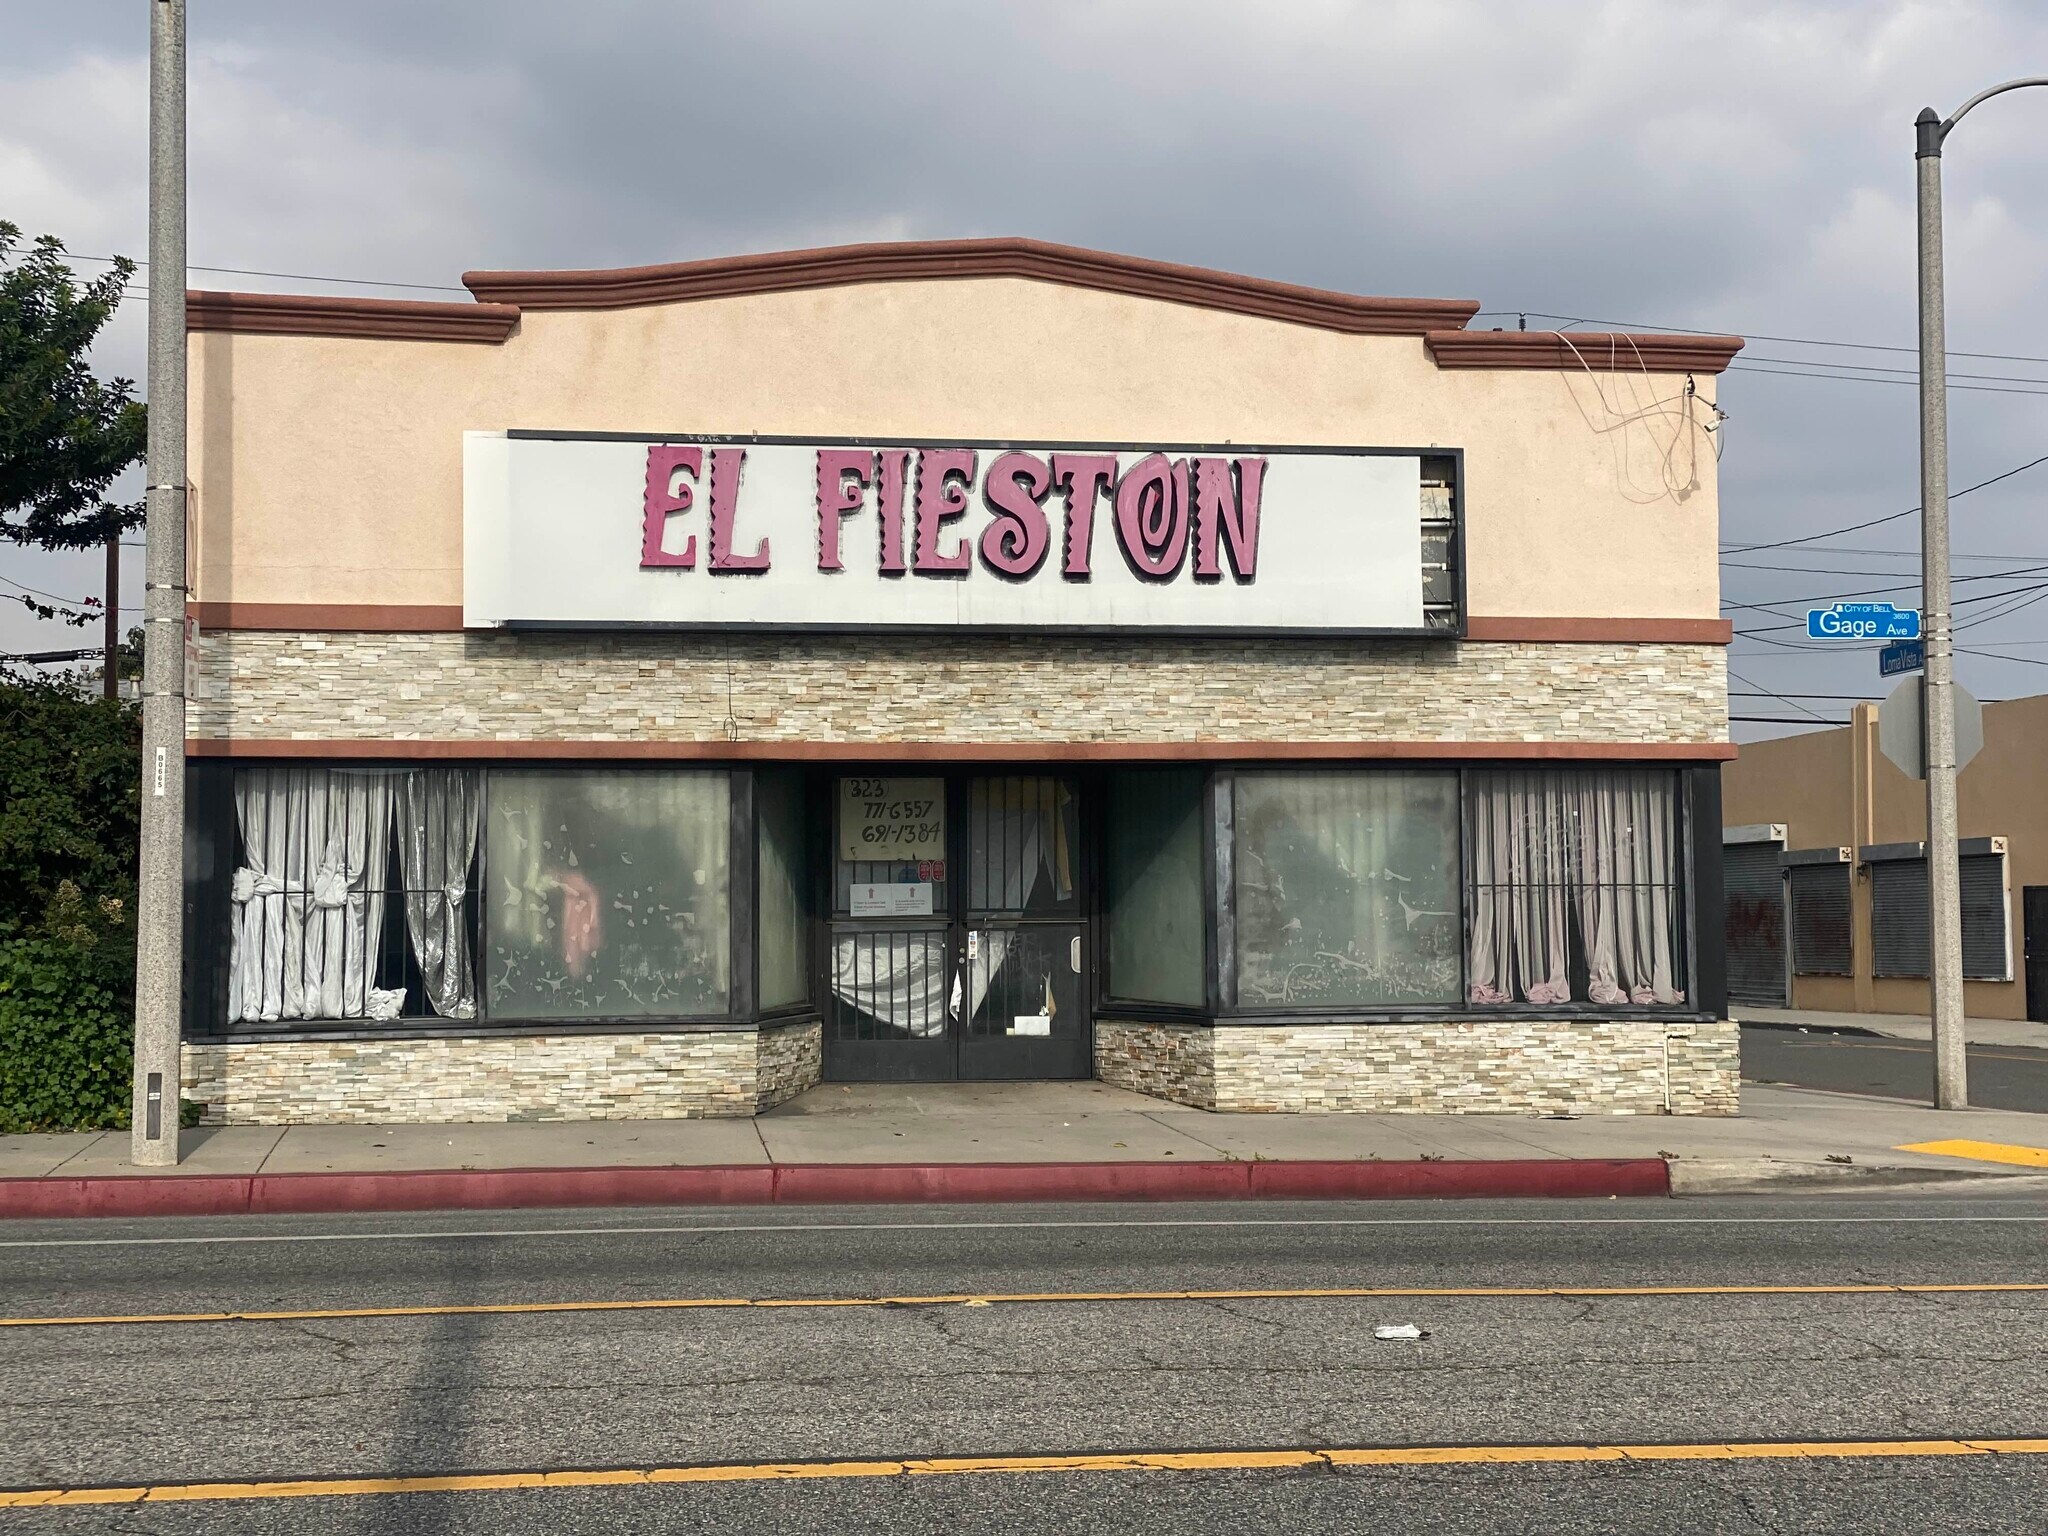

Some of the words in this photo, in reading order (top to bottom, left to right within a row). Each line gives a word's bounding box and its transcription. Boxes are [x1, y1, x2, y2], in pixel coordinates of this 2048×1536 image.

[639, 445, 771, 576] EL
[814, 448, 1268, 585] FIESTON
[1844, 604, 1862, 613] CITY
[1862, 605, 1873, 613] OF
[1873, 604, 1891, 613] BELL
[1819, 611, 1877, 637] Gage
[1886, 624, 1908, 636] Ave
[1883, 653, 1901, 673] Loma
[1899, 649, 1917, 669] Vista
[863, 801, 934, 819] 771-6557
[862, 821, 940, 843] 691-1384
